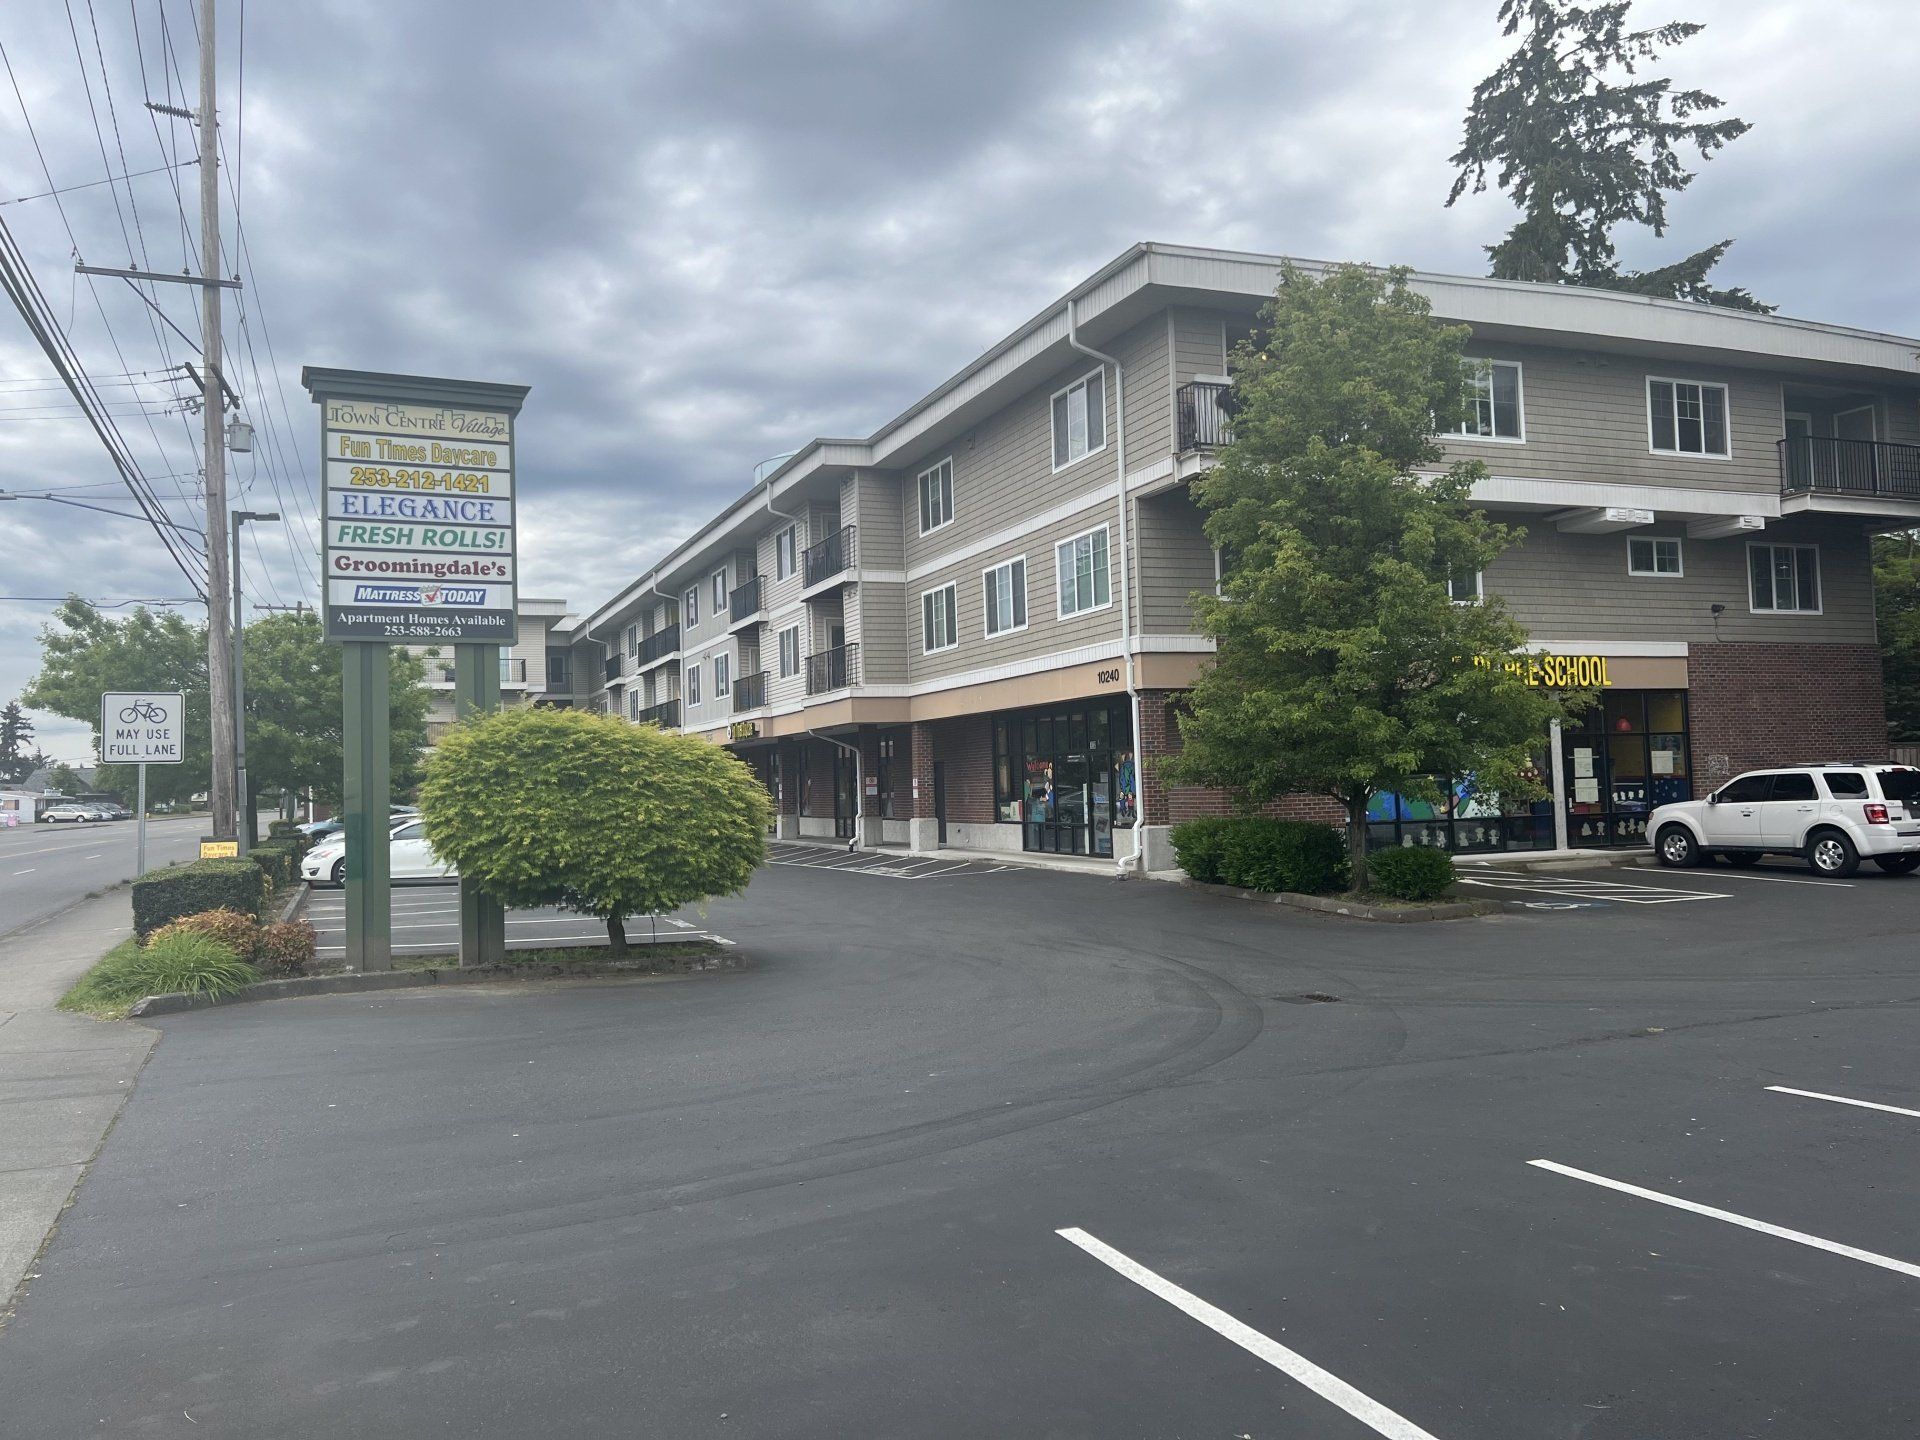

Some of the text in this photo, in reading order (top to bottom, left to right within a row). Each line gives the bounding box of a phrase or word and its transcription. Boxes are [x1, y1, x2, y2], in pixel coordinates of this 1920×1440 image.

[330, 407, 506, 438] TOWN CENTRE Village
[340, 435, 497, 466] Fun Times Daycare
[350, 466, 489, 493] 253-212-1421
[342, 494, 494, 521] ELEGANCE
[338, 525, 505, 548] FRESH ROLLS!
[334, 555, 506, 577] Groomingdale's
[357, 587, 421, 601] MATTRESS
[440, 589, 483, 603] TODAY
[337, 612, 506, 626] Apartment Homes Available
[384, 625, 462, 637] 253-588-2663
[1097, 668, 1120, 684] 10240
[1505, 656, 1612, 686] E-SCHOOL
[116, 729, 170, 740] MAY USE
[110, 744, 177, 756] FULL LANE
